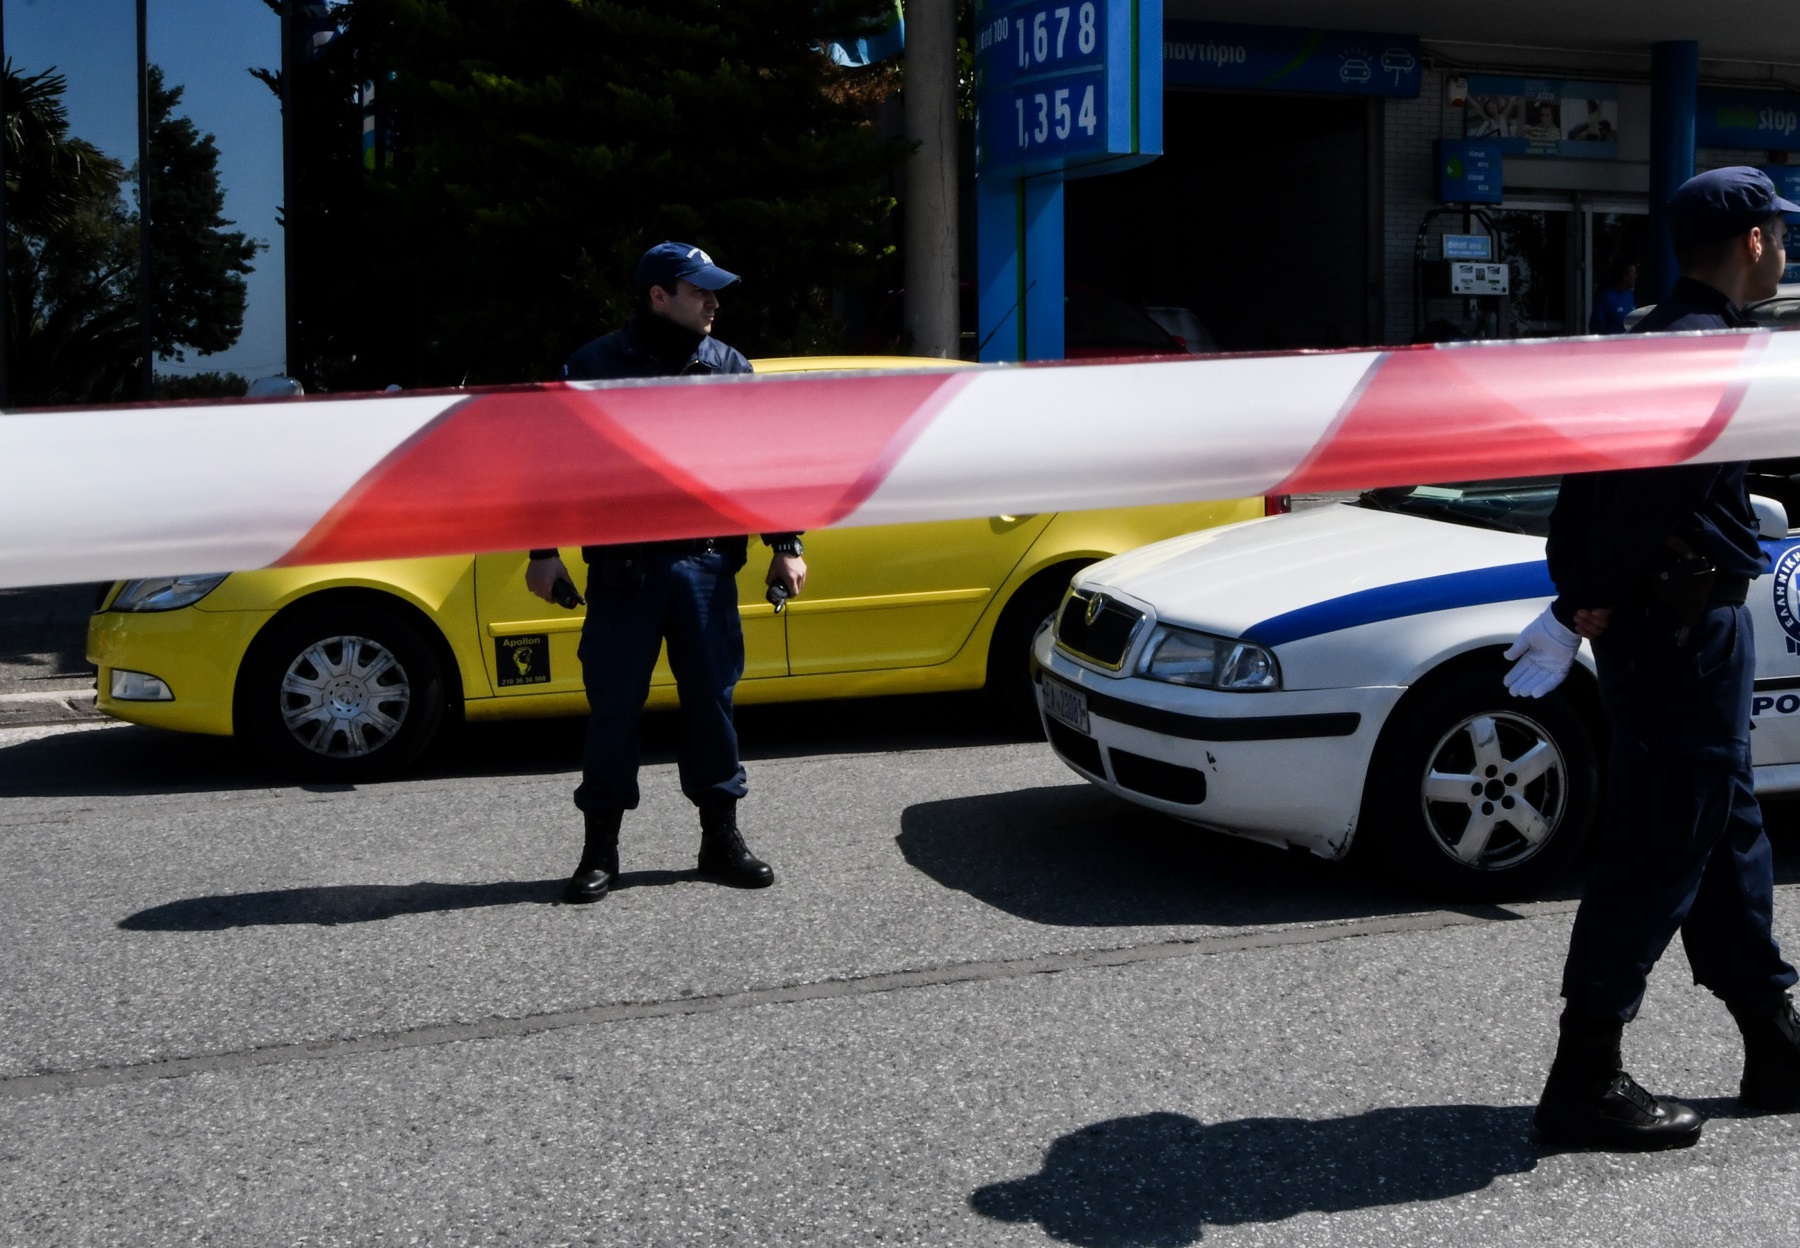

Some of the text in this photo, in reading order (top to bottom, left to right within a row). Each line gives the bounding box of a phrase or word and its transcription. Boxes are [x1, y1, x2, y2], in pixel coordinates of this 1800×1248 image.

[993, 16, 1009, 44] 100
[1016, 2, 1096, 69] 1,678
[1015, 85, 1097, 149] 1,354
[502, 637, 541, 648] Apollon
[501, 678, 514, 686] 210
